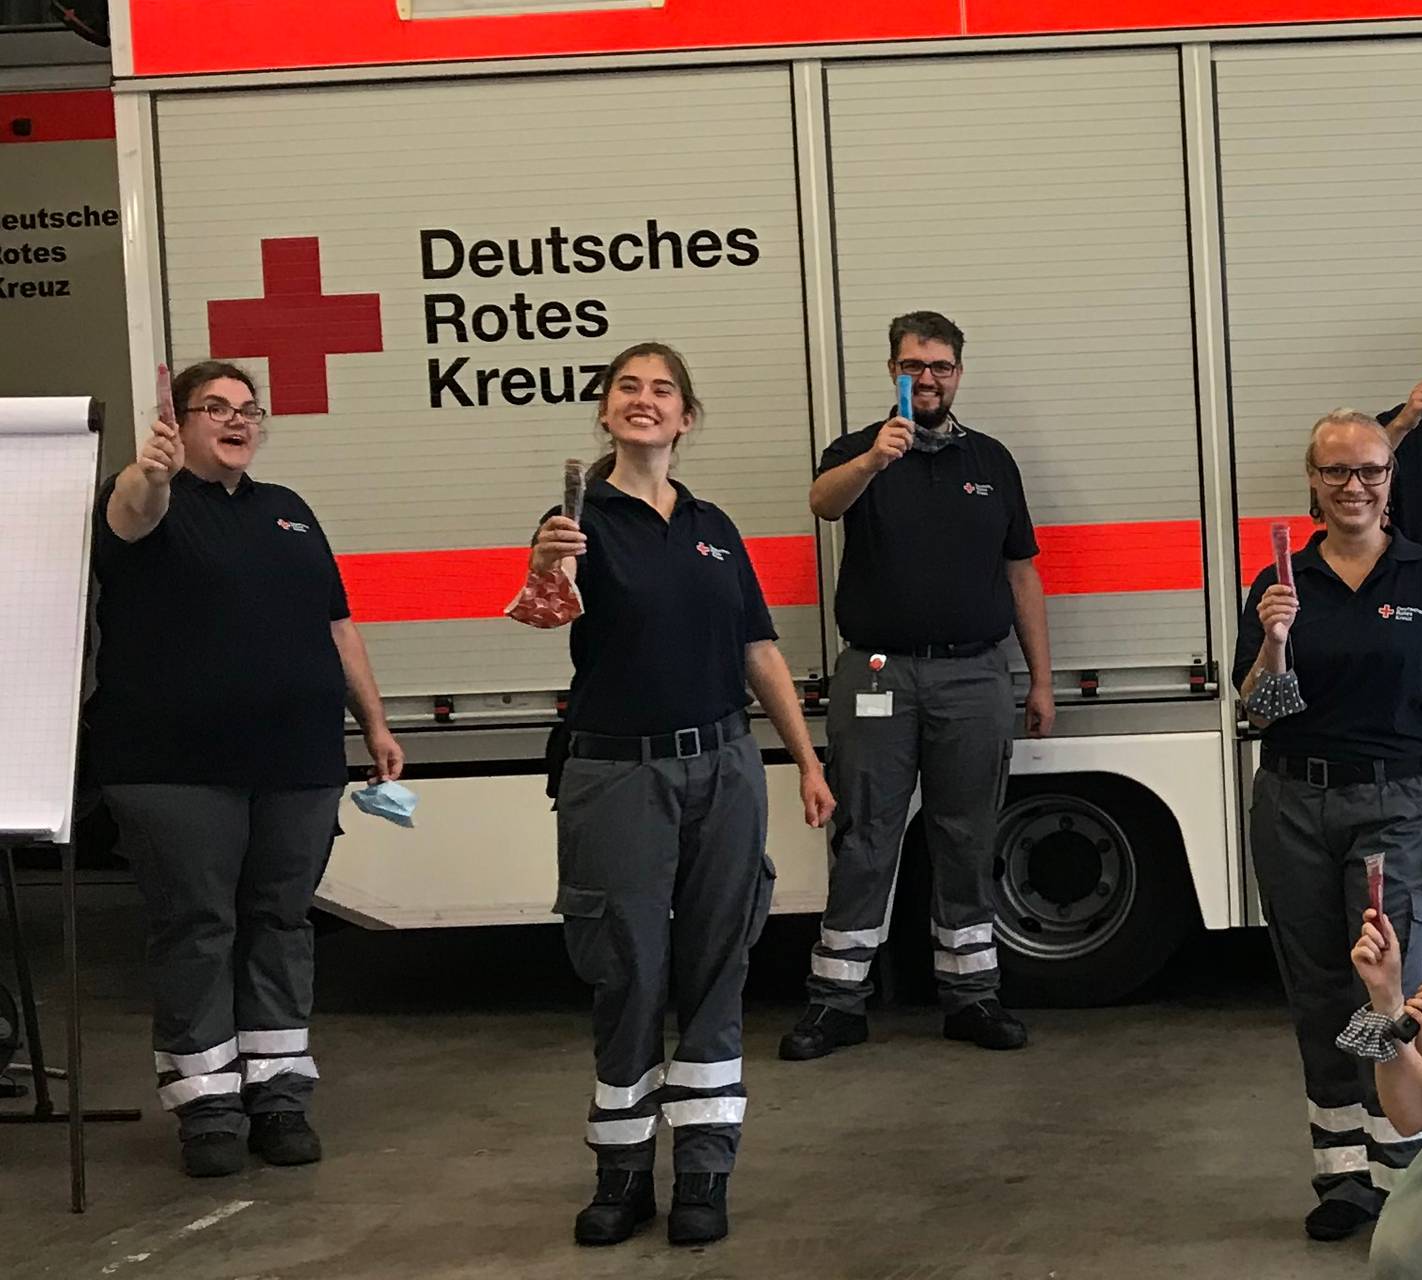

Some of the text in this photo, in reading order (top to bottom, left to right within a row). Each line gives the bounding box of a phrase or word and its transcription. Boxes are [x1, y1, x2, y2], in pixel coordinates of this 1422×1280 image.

[0, 205, 119, 230] eutsche
[0, 243, 67, 265] otes
[420, 219, 760, 279] Deutsches
[424, 292, 609, 344] Rotes
[428, 356, 610, 408] Kreuz
